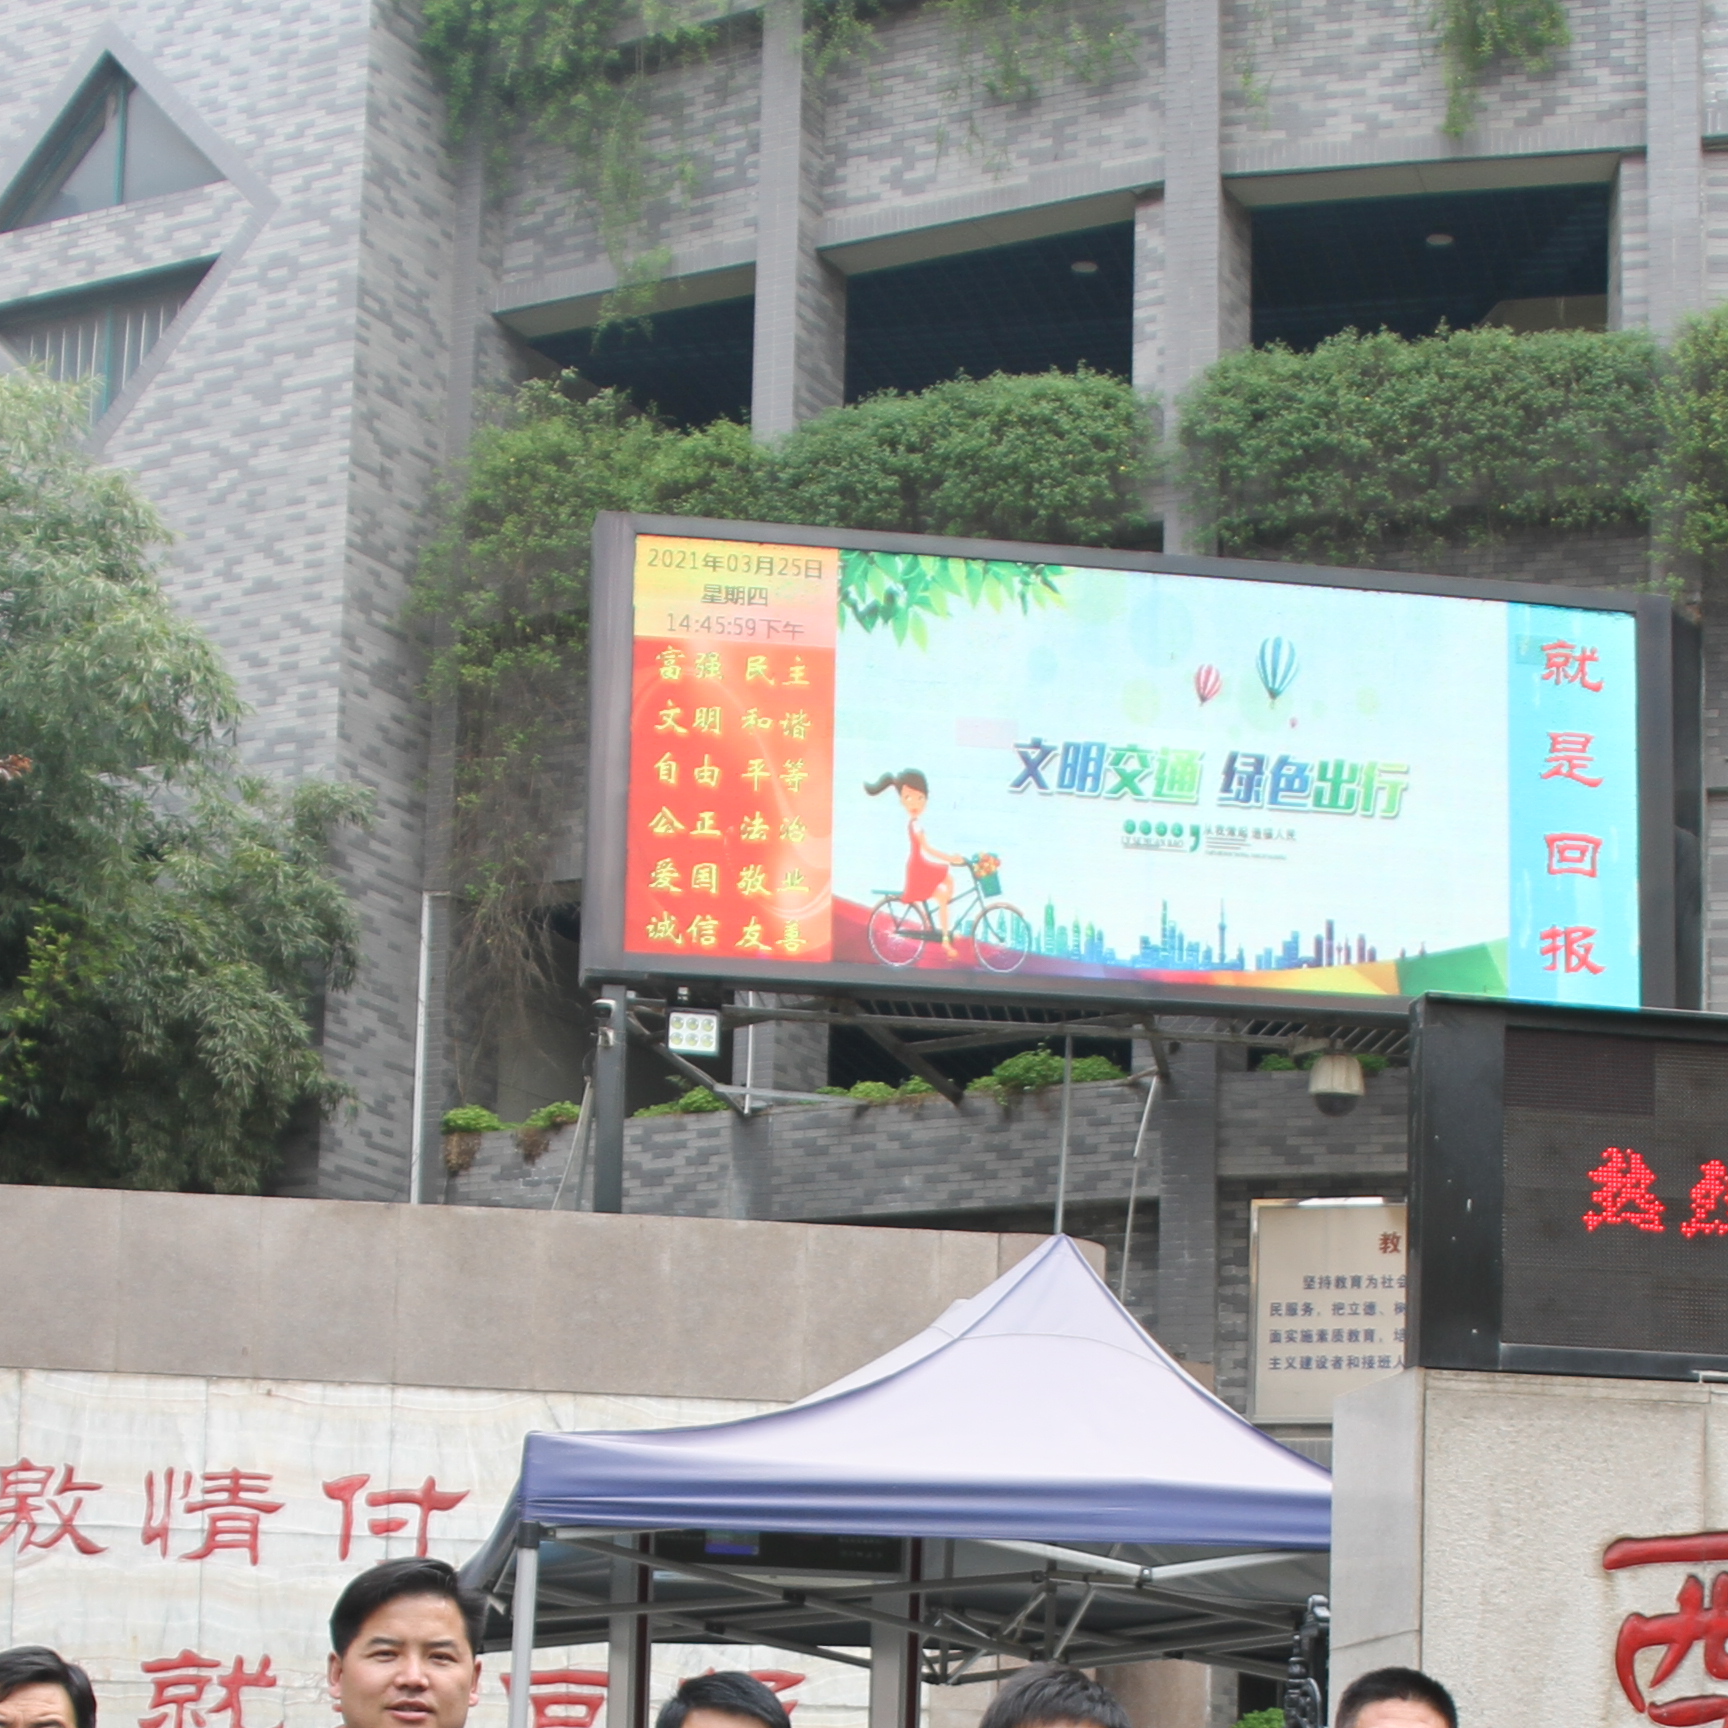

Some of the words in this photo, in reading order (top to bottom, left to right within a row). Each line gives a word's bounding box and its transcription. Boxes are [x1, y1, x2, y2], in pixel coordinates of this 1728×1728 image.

[647, 548, 823, 579] 2021年03月25日
[701, 583, 769, 607] 星期四
[667, 612, 804, 640] 14:45:59下午
[656, 645, 724, 681] 富强
[745, 655, 811, 685] 民主
[654, 699, 723, 735] 文明
[741, 707, 811, 739] 和谐
[654, 752, 721, 787] 自由
[741, 758, 809, 792] 平等
[1008, 738, 1204, 804] 文明交通
[1217, 750, 1411, 818] 绿色出行
[648, 805, 722, 836] 公正
[740, 811, 806, 843] 法治
[1540, 640, 1606, 976] 就是回报
[648, 857, 719, 894] 爱国
[737, 864, 810, 895] 敬业
[646, 910, 719, 945] 诚信
[734, 915, 807, 952] 友善
